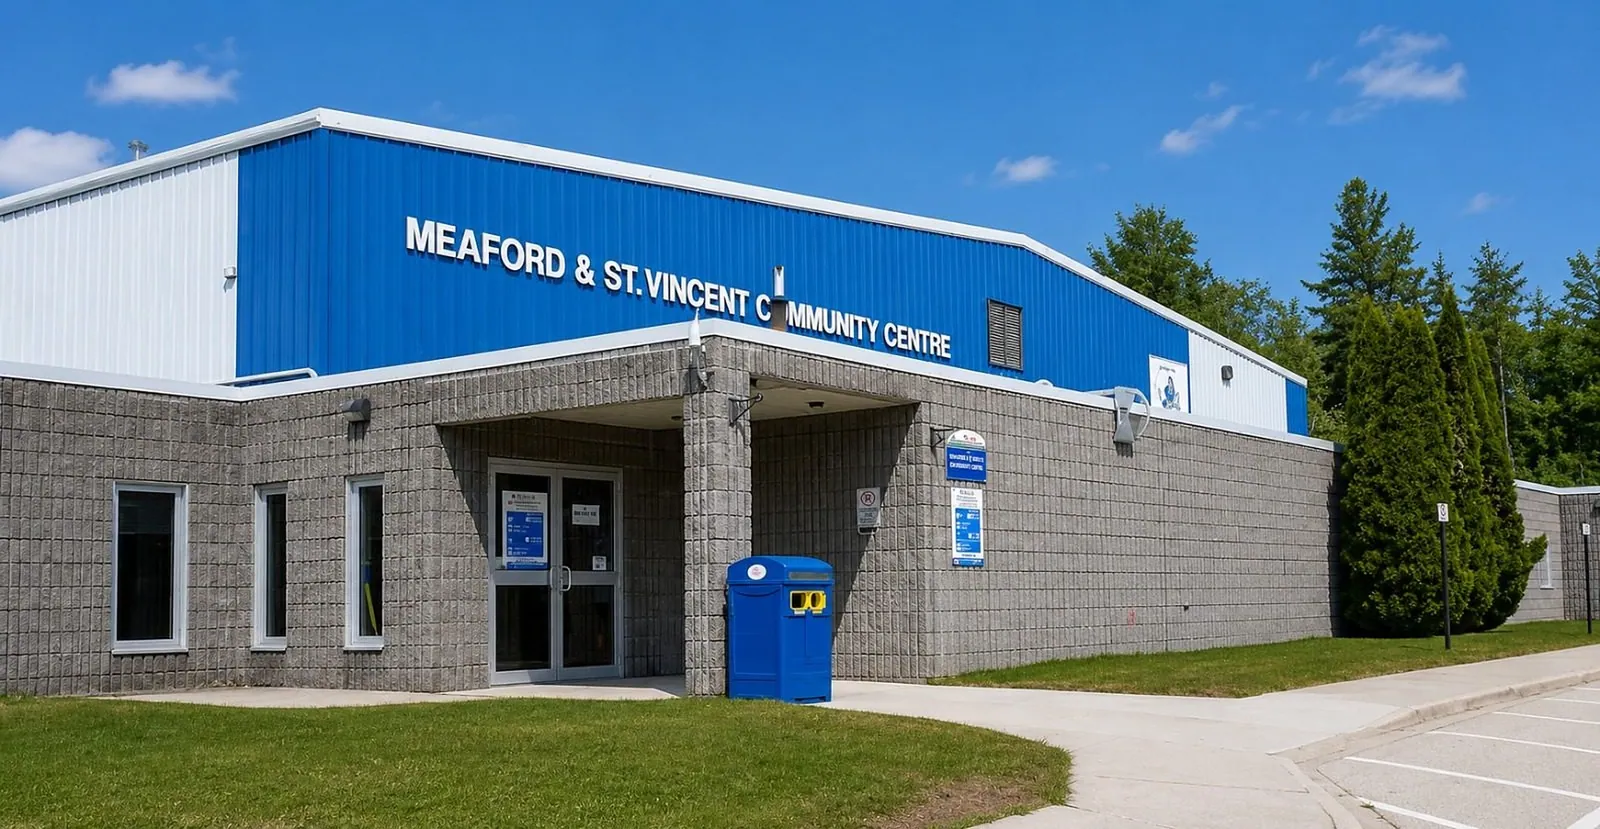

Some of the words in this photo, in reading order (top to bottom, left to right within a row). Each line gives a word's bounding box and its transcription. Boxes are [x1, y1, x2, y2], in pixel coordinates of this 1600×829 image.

[406, 216, 566, 279] MEAFORD
[574, 254, 596, 286] &
[604, 260, 643, 297] ST.
[644, 268, 750, 317] VINCENT
[756, 293, 879, 343] CMMUNITY
[884, 323, 952, 359] CENTRE
